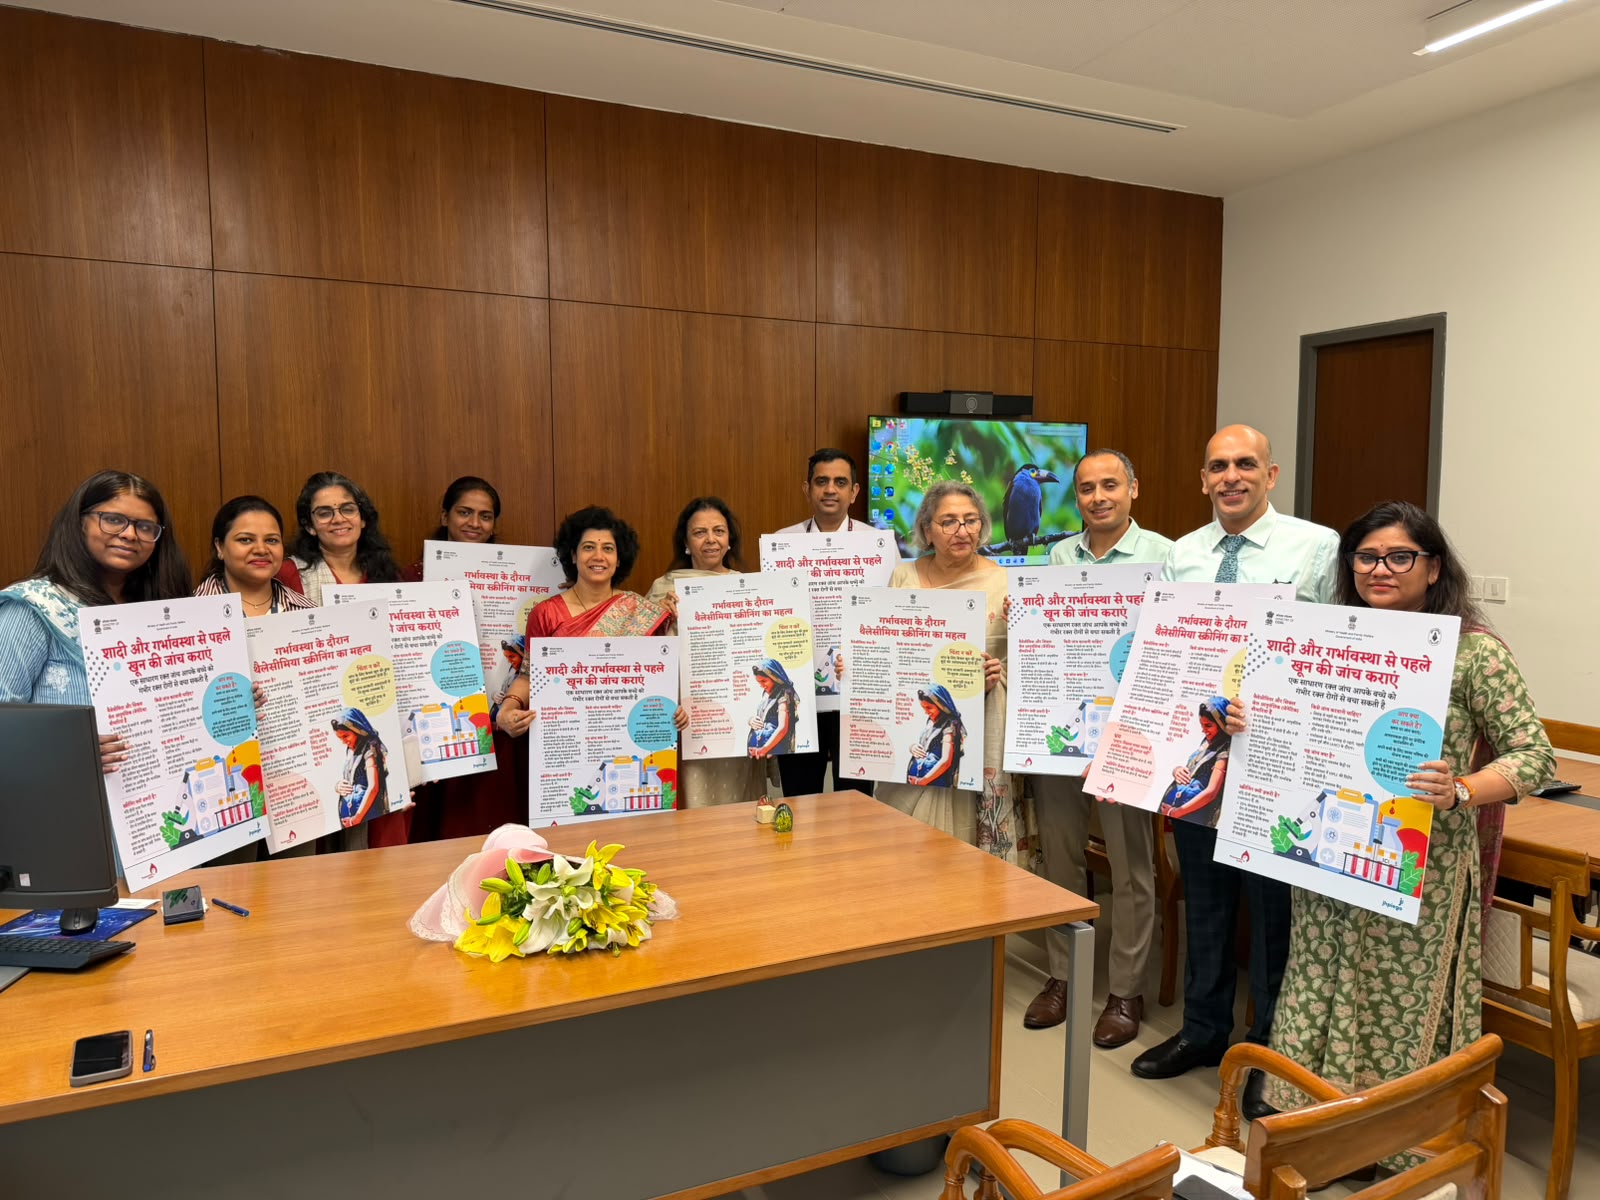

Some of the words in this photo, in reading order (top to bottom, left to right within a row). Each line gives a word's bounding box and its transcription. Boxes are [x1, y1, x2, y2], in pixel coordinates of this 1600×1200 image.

[775, 557, 795, 569] शादी
[797, 556, 813, 567] और
[815, 556, 851, 566] गर्भावस्था
[852, 555, 861, 565] से
[862, 554, 882, 566] पहले
[464, 570, 499, 580] गर्भावस्था
[500, 571, 508, 580] के
[510, 571, 532, 582] दौरान
[810, 567, 822, 577] की
[823, 568, 841, 577] जांच
[842, 566, 864, 577] कराएं
[486, 581, 516, 592] स्क्रीनिंग
[530, 586, 549, 594] महत्व
[712, 600, 743, 609] गर्भावस्था
[745, 598, 752, 607] के
[754, 596, 774, 608] दौरान
[1022, 593, 1045, 607] शादी
[1048, 592, 1066, 605] और
[1068, 593, 1112, 605] गर्भावस्था
[1113, 592, 1124, 604] से
[427, 608, 436, 618] से
[438, 606, 459, 619] पहले
[695, 611, 732, 621] थैलेसीमिया
[733, 609, 760, 618] स्क्रीनिंग
[773, 608, 792, 616] महत्व
[1043, 610, 1060, 622] खून
[1062, 605, 1076, 618] की
[1078, 606, 1099, 618] जांच
[1100, 606, 1128, 619] कराएं
[396, 622, 415, 632] जांच
[417, 620, 442, 632] कराएं
[879, 615, 913, 625] गर्भावस्था
[915, 616, 922, 626] के
[924, 615, 946, 628] दौरान
[1178, 614, 1213, 630] गर्भावस्था
[1214, 616, 1223, 627] के
[1224, 615, 1248, 630] दौरान
[860, 624, 900, 636] थैलेसीमिया
[901, 627, 930, 638] स्क्रीनिंग
[945, 632, 966, 641] महत्व
[1155, 624, 1196, 639] थैलेसीमिया
[1198, 628, 1229, 642] स्क्रीनिंग
[1230, 634, 1242, 643] का
[101, 640, 128, 660] शादी
[130, 637, 150, 655] और
[152, 634, 195, 651] गर्भावस्था
[196, 630, 207, 645] से
[208, 627, 231, 644] पहले
[274, 642, 314, 655] गर्भावस्था
[315, 638, 324, 648] के
[326, 634, 349, 648] दौरान
[127, 659, 146, 677] खून
[148, 652, 162, 668] की
[164, 652, 185, 666] जांच
[186, 646, 213, 662] कराएं
[253, 657, 300, 674] थैलेसीमिया
[302, 649, 334, 664] स्क्रीनिंग
[336, 649, 348, 658] का
[350, 645, 372, 656] महत्व
[1266, 637, 1296, 656] शादी
[1299, 639, 1324, 658] और
[1326, 645, 1382, 666] गर्भावस्था
[1384, 650, 1398, 668] से
[1400, 655, 1432, 674] पहले
[545, 663, 568, 676] शादी
[571, 662, 589, 674] और
[591, 662, 631, 674] गर्भावस्था
[633, 662, 642, 673] से
[644, 662, 665, 674] पहले
[1291, 660, 1314, 678] खून
[1316, 658, 1334, 676] की
[1336, 664, 1363, 680] जांच
[1365, 670, 1400, 689] कराएं
[566, 678, 583, 690] खून
[585, 674, 598, 685] की
[600, 675, 619, 685] जांच
[621, 674, 645, 686] कराएं
[1300, 680, 1323, 688] साधारण
[1338, 685, 1351, 693] जांच
[1353, 687, 1372, 696] आपके
[1373, 690, 1386, 700] बच्चे
[1388, 691, 1396, 700] को
[1296, 687, 1311, 696] गंभीर
[1326, 691, 1338, 701] रोगों
[1340, 694, 1346, 702] से
[1361, 699, 1379, 708] सकती
[1381, 699, 1386, 710] है
